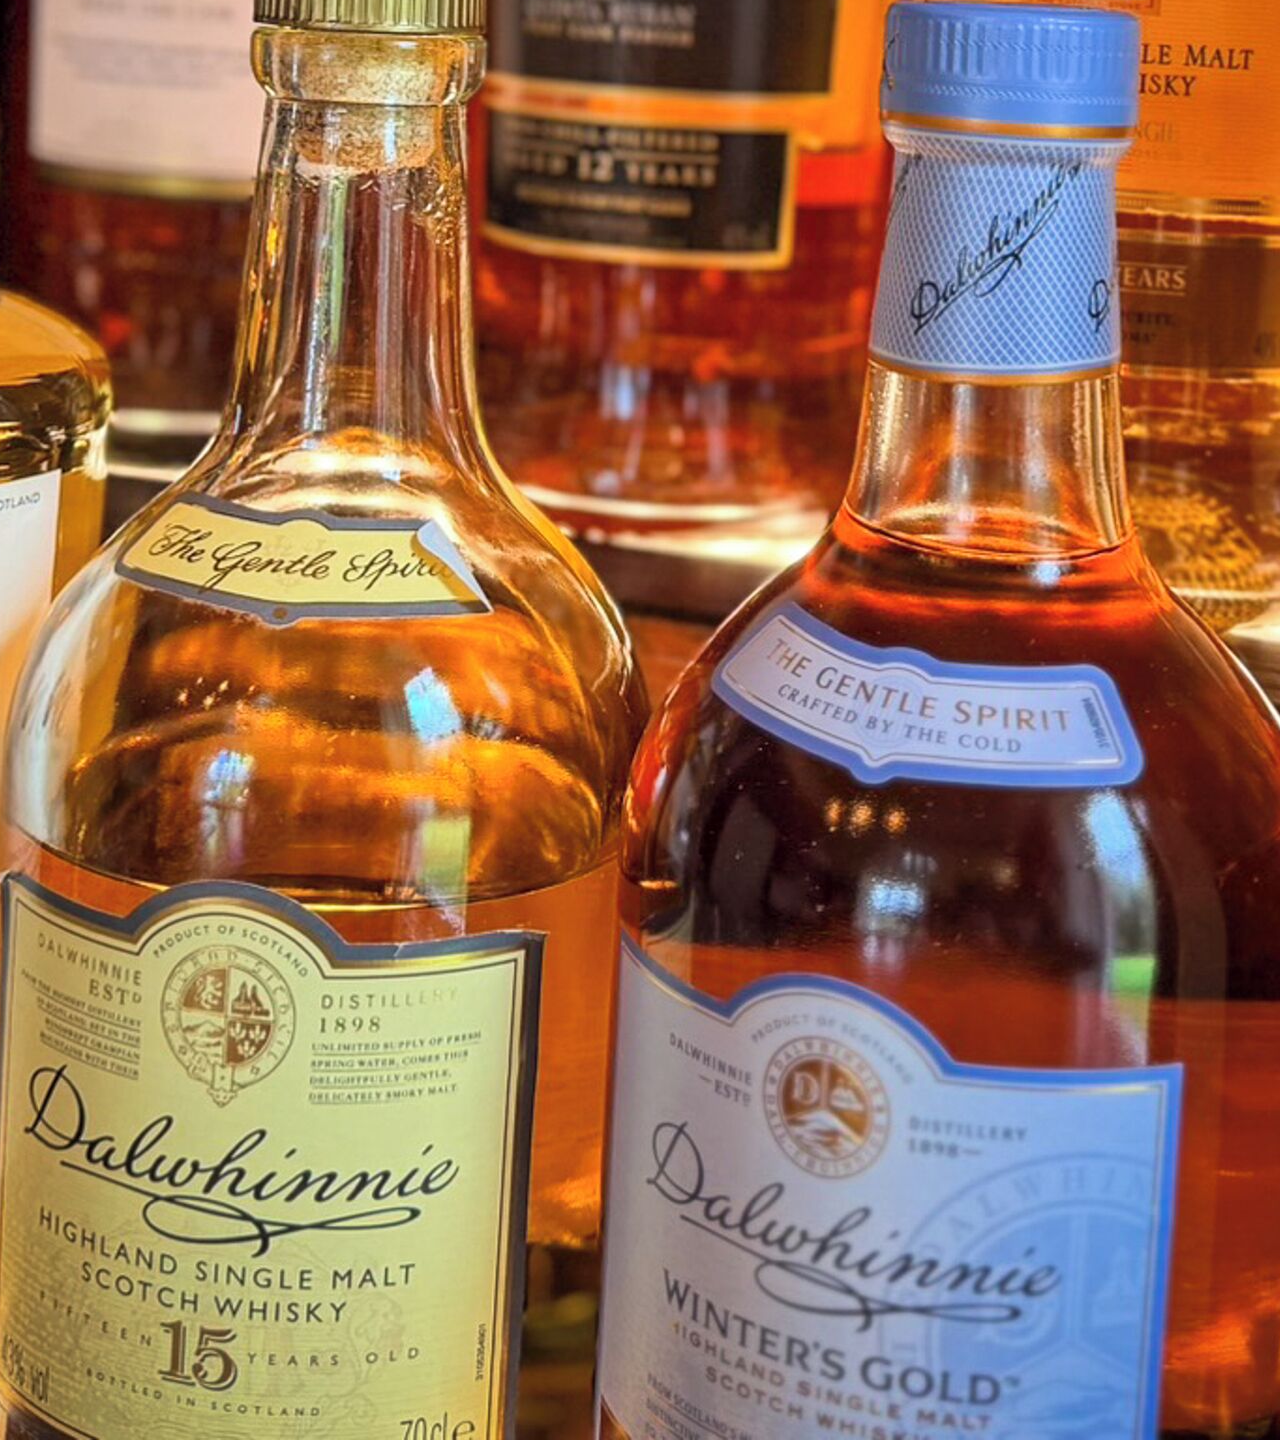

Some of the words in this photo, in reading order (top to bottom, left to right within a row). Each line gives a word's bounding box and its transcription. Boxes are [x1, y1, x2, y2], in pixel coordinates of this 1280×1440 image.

[1184, 44, 1255, 71] MALT
[577, 150, 614, 182] 12
[148, 523, 213, 564] The
[199, 541, 337, 596] Gentle
[765, 637, 813, 679] THE
[815, 665, 939, 720] GENTLE
[952, 699, 1071, 733] SPIRIT
[777, 682, 859, 726] CRAFTED
[864, 713, 895, 735] BY
[904, 722, 948, 747] THE
[957, 732, 1022, 755] COLD
[37, 932, 143, 988] DALWHINNIE
[152, 924, 211, 959] PRODUCT
[217, 924, 235, 935] OF
[241, 928, 309, 979] SCOTLAND
[320, 986, 458, 1010] DISTILLERY
[320, 1015, 382, 1035] 1898
[667, 1031, 755, 1088] DALWHINNIE
[24, 1063, 460, 1212] Dalwhinnie
[647, 1121, 1061, 1306] Dalwhinnie
[38, 1205, 179, 1276] HIGHLAND
[194, 1260, 314, 1292] SINGLE
[331, 1262, 418, 1290] MALT
[80, 1262, 200, 1313] SCOTCH
[213, 1294, 349, 1324] WHISKY
[661, 1266, 847, 1383] WINTER'S
[156, 1319, 238, 1392] 15
[246, 1351, 340, 1368] YEARS
[365, 1347, 420, 1365] OLD
[86, 1367, 163, 1401] BOTTLED
[176, 1394, 196, 1408] IN
[211, 1401, 321, 1418] SCOTLAND
[705, 1365, 805, 1423] SCOTCH
[796, 1379, 902, 1420] SINGLE
[918, 1406, 994, 1432] MALT
